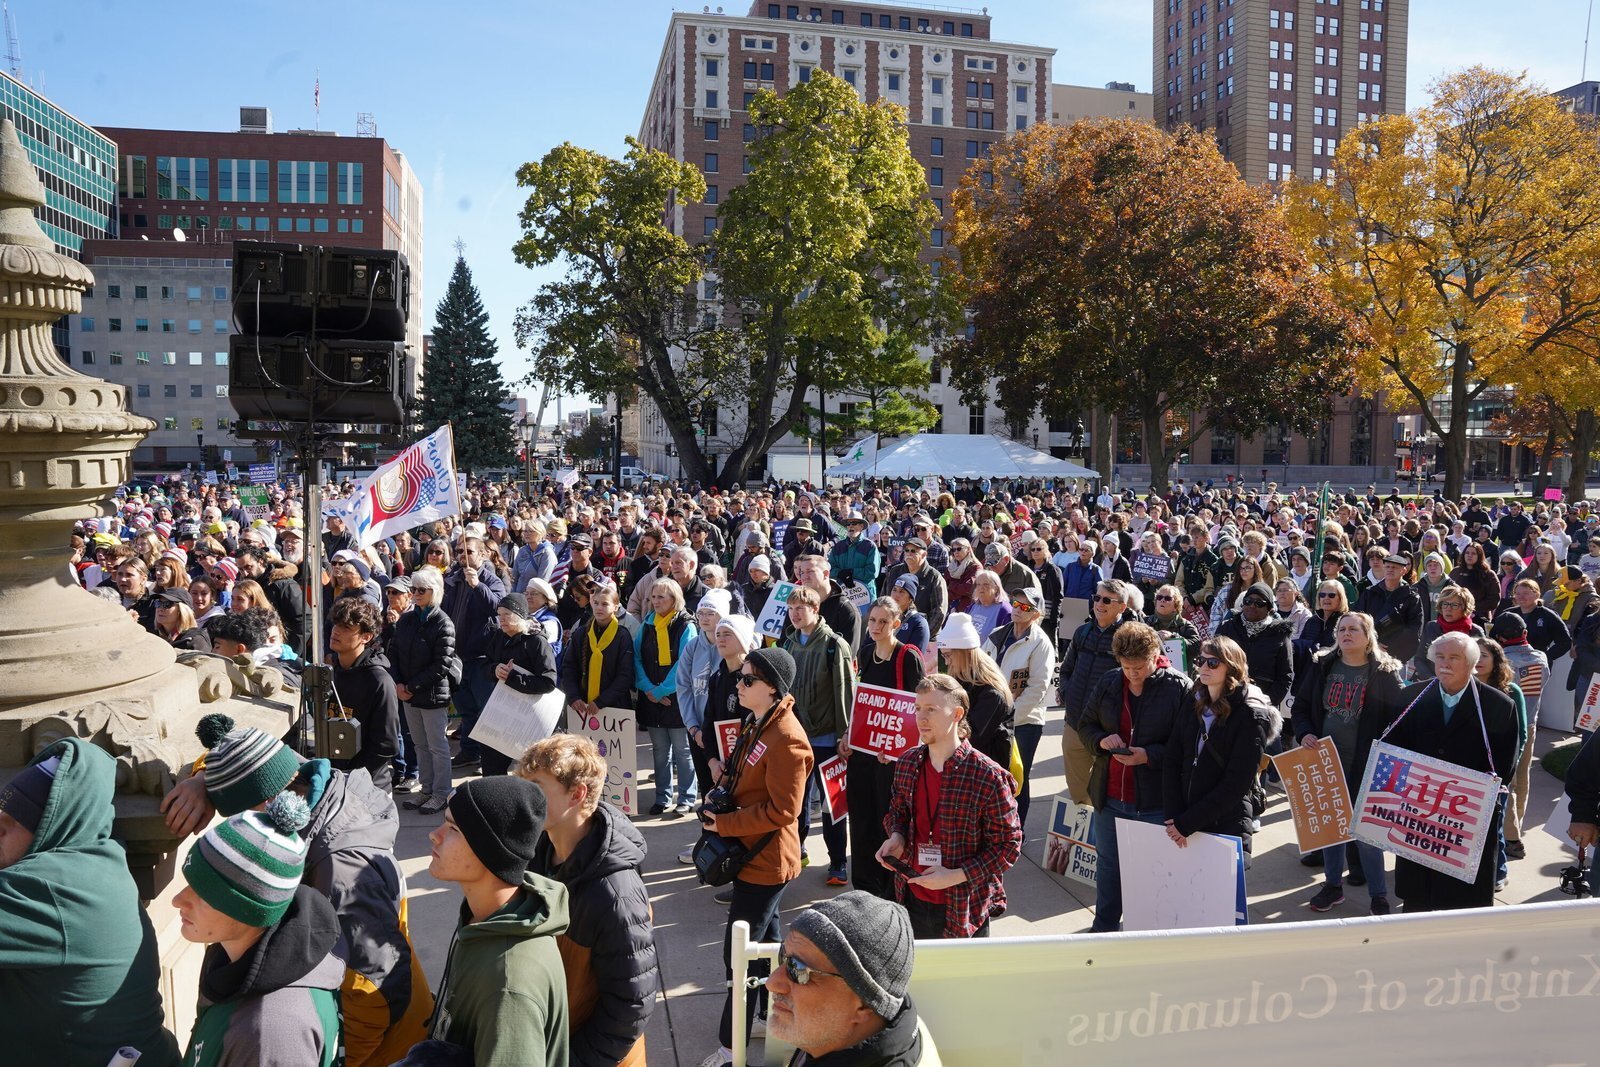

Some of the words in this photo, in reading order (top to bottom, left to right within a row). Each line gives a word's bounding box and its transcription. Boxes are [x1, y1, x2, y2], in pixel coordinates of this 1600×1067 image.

[240, 487, 252, 497] LOVE
[252, 487, 265, 496] LIFE
[246, 506, 267, 514] CHOOSE
[1133, 567, 1166, 578] GENERATION
[1134, 560, 1168, 573] PRO-LIFE
[1155, 558, 1168, 566] THE
[775, 605, 787, 617] Th
[763, 619, 783, 635] Ch
[1013, 670, 1029, 680] Bab
[857, 692, 887, 708] GRAND
[888, 698, 917, 715] RAPID
[576, 709, 631, 733] Your
[866, 710, 904, 732] LOVES
[590, 737, 622, 759] OM
[868, 731, 894, 751] LIFE
[1318, 744, 1337, 784] ESUS
[1293, 764, 1320, 834] FORGIVES
[1308, 764, 1329, 811] HEALS
[1322, 814, 1332, 825] &
[1381, 759, 1469, 819] Life
[1371, 804, 1465, 847] INALIENABLE
[1400, 802, 1419, 815] the
[1437, 814, 1465, 830] first
[1075, 846, 1096, 865] RESP
[1404, 831, 1451, 858] RIGHT
